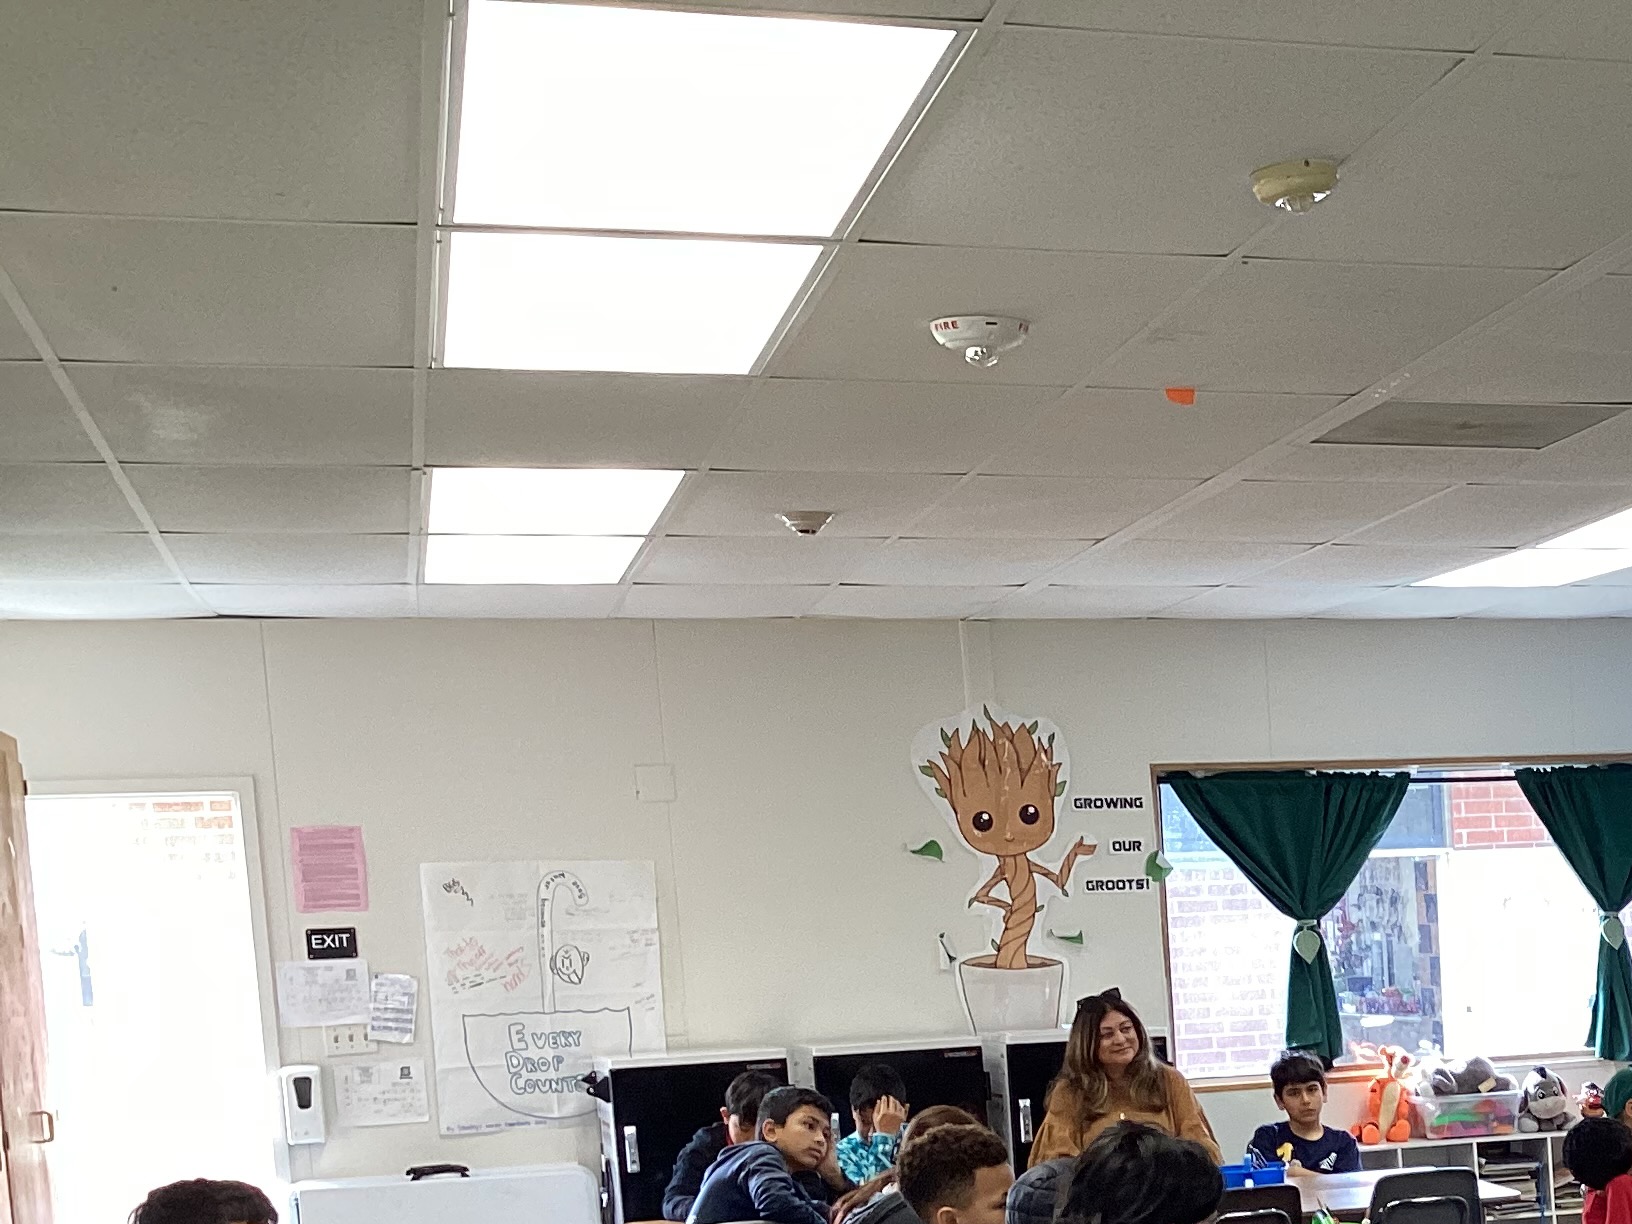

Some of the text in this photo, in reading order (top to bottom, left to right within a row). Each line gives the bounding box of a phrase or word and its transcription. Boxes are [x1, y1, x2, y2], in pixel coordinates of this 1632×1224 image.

[934, 320, 959, 332] FIRE
[1073, 797, 1144, 809] GROWING
[1112, 840, 1142, 852] OUR
[1086, 878, 1150, 891] GROOTS!
[311, 933, 350, 949] EXIT
[508, 1022, 582, 1050] EVERY
[505, 1051, 564, 1075] DROP
